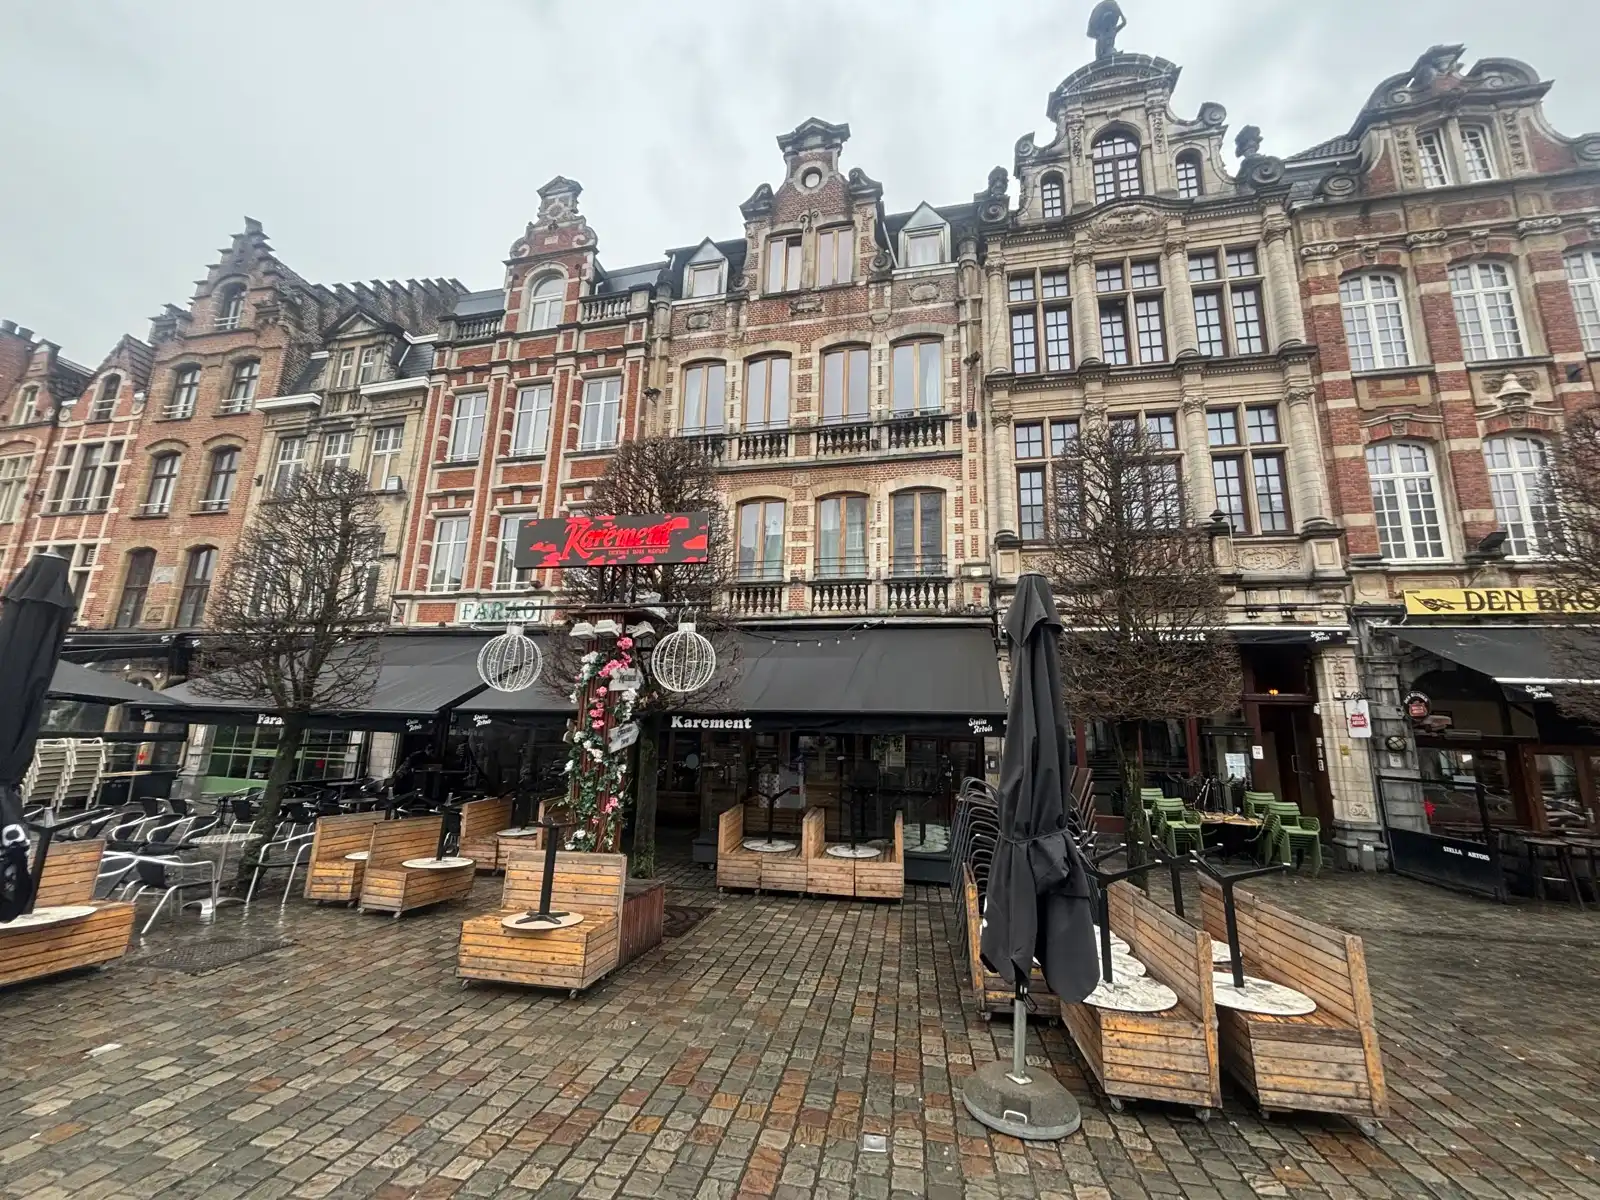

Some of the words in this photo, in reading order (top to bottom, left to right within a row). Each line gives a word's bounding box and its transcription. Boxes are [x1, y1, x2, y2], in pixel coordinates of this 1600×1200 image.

[1462, 589, 1527, 611] DEN
[670, 715, 753, 729] Karement
[1442, 845, 1463, 856] STELLA
